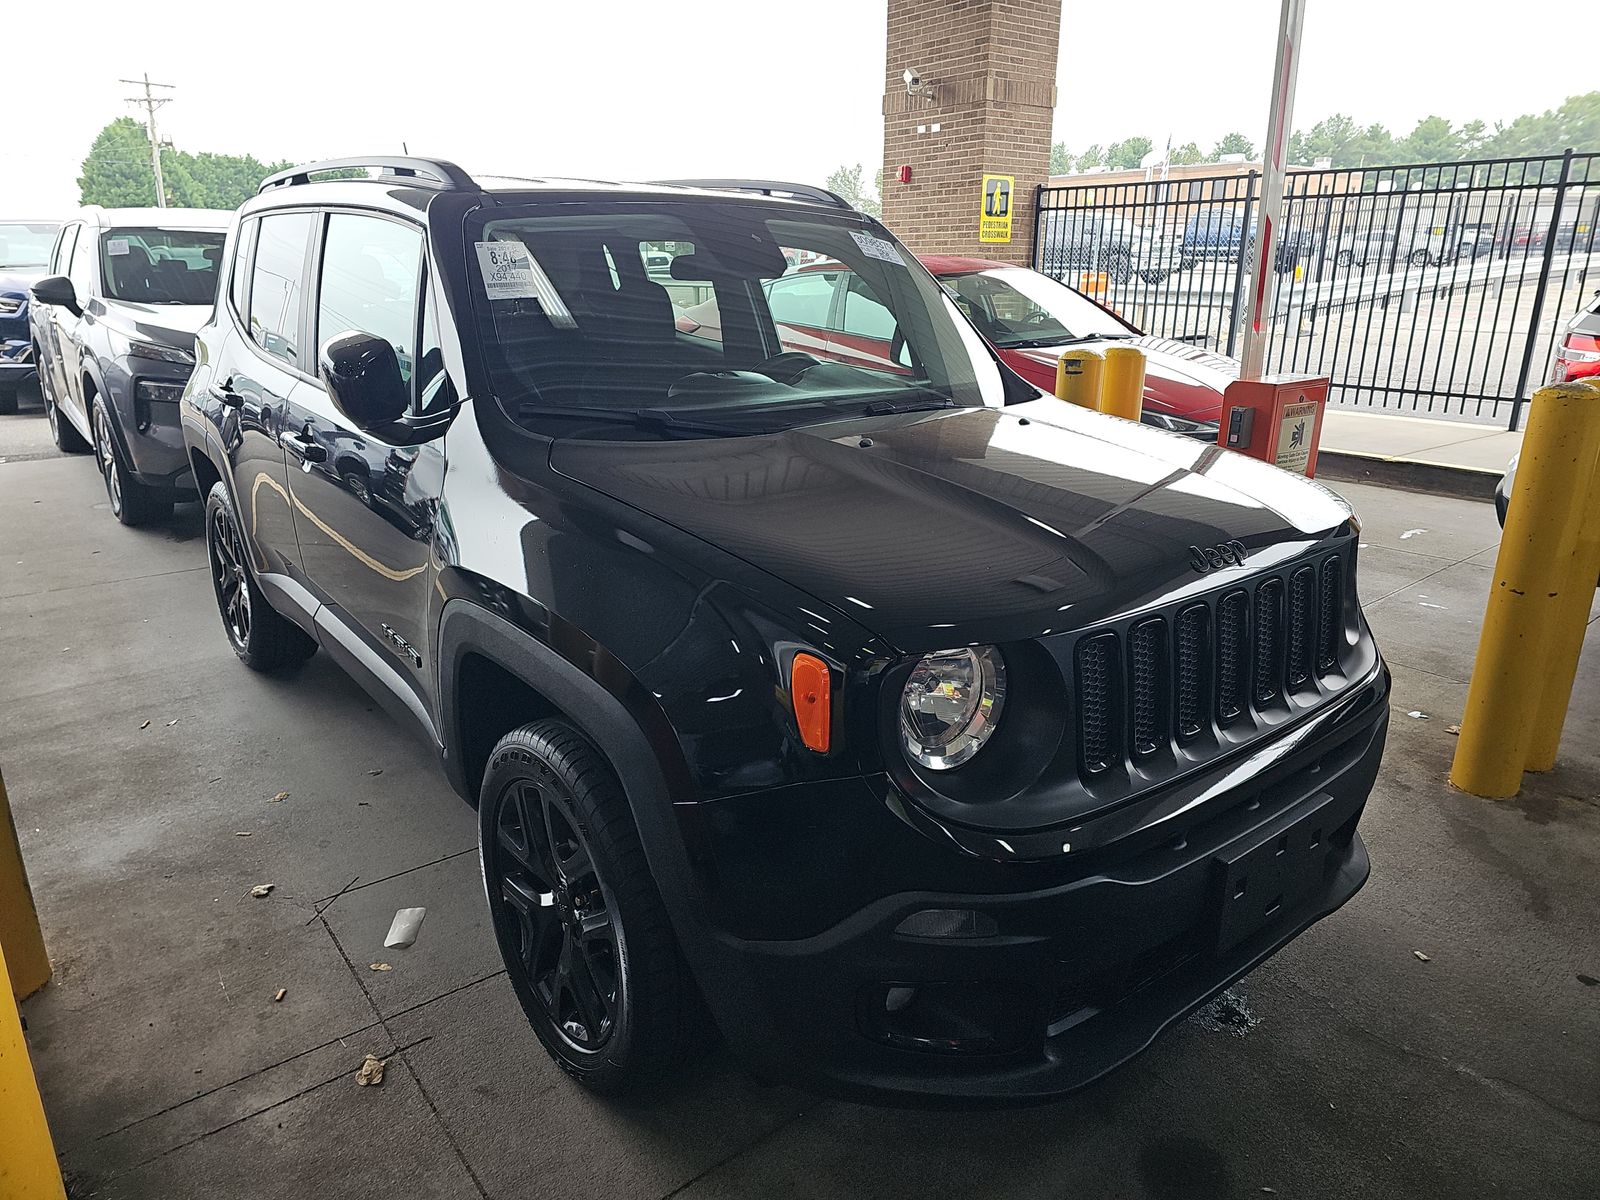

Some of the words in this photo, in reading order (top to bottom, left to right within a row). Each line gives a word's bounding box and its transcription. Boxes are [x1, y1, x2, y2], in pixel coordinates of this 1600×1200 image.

[982, 220, 1009, 229] PEDESTRIAN
[981, 230, 1009, 239] CROSSWALK
[495, 264, 517, 272] 2017
[1290, 404, 1315, 417] WARNING
[1189, 539, 1249, 573] Jeep
